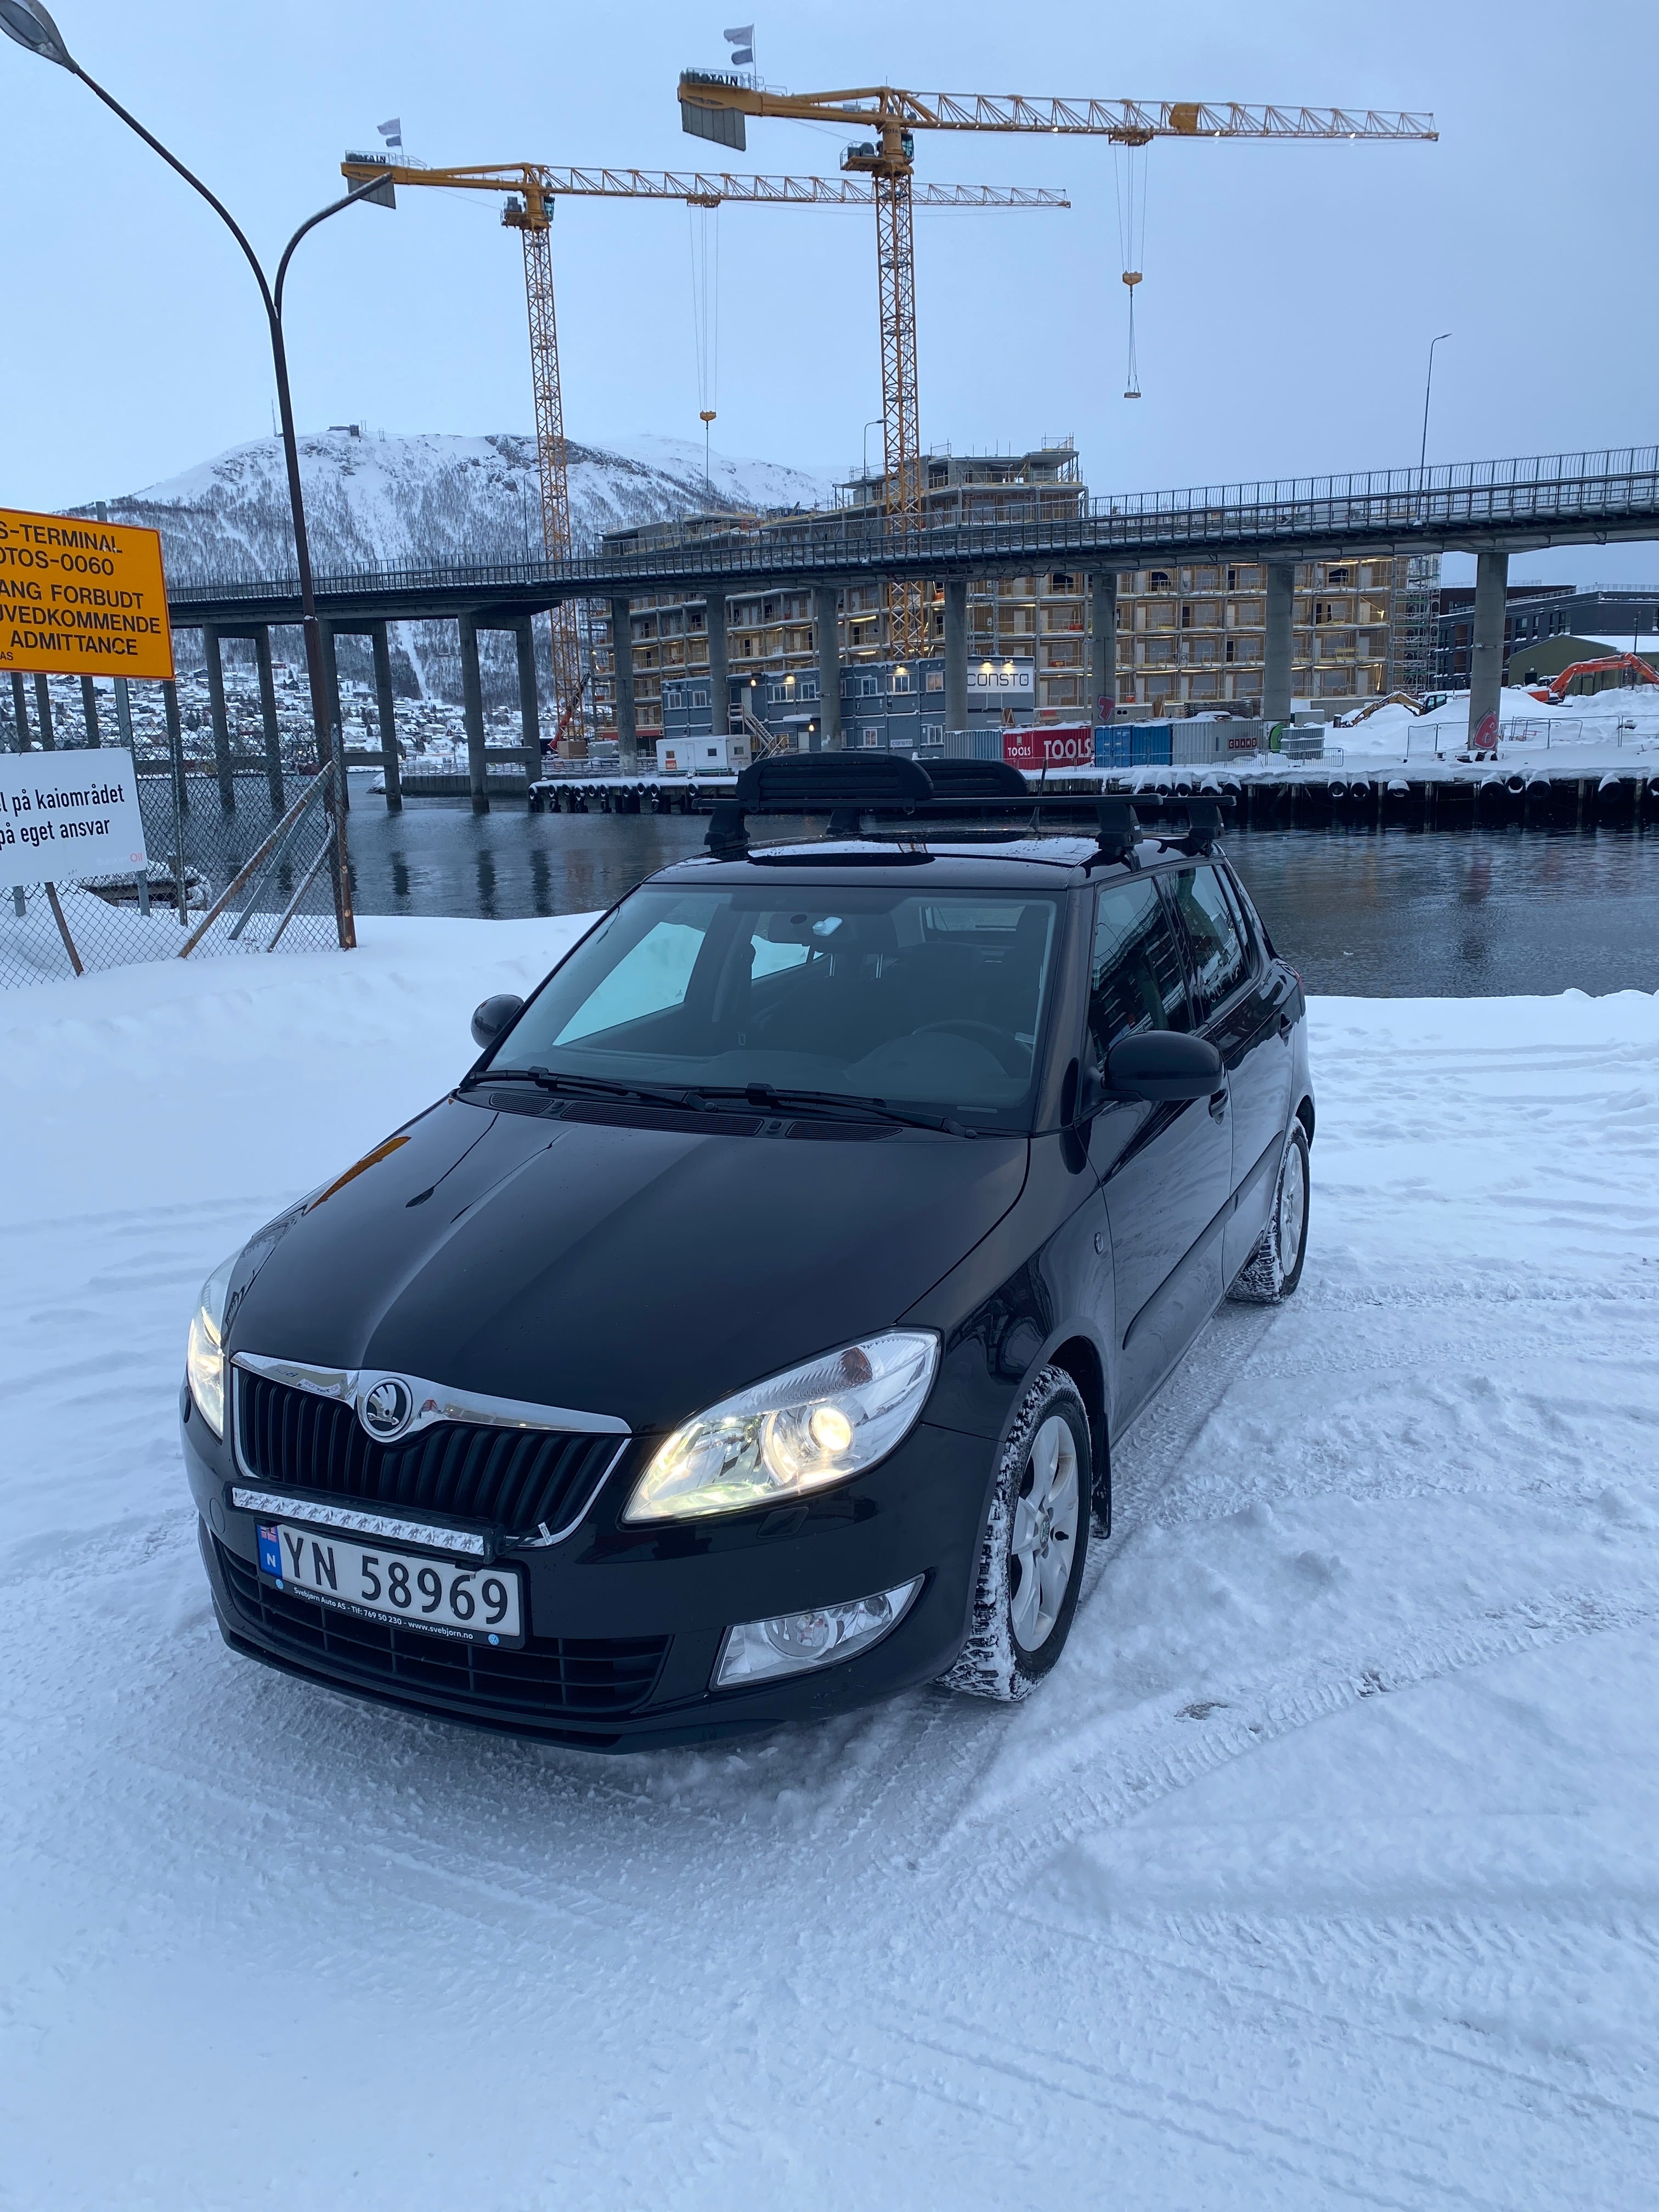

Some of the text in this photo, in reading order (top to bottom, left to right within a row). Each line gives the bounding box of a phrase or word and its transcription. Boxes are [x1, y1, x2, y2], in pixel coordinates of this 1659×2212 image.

[0, 521, 122, 554] S-TERMINAL
[0, 579, 143, 609] ANG FORBUDT
[0, 651, 14, 661] AS
[10, 630, 138, 655] ADMITTANCE
[1008, 747, 1030, 757] TOOLS
[1044, 738, 1091, 759] TOOLS
[0, 783, 125, 817] l på kaiområdet
[21, 821, 55, 847] eget
[59, 819, 110, 839] ansvar
[267, 1553, 276, 1567] N
[284, 1532, 508, 1625] YN 58969
[294, 1587, 320, 1602] Svebjørn
[321, 1596, 336, 1607] Auto
[337, 1600, 346, 1610] AS
[351, 1605, 363, 1615] Tlf:
[363, 1609, 376, 1618] 769
[377, 1612, 387, 1622] 50
[388, 1615, 402, 1626] 230
[408, 1622, 473, 1640] www.svebjorn.no
